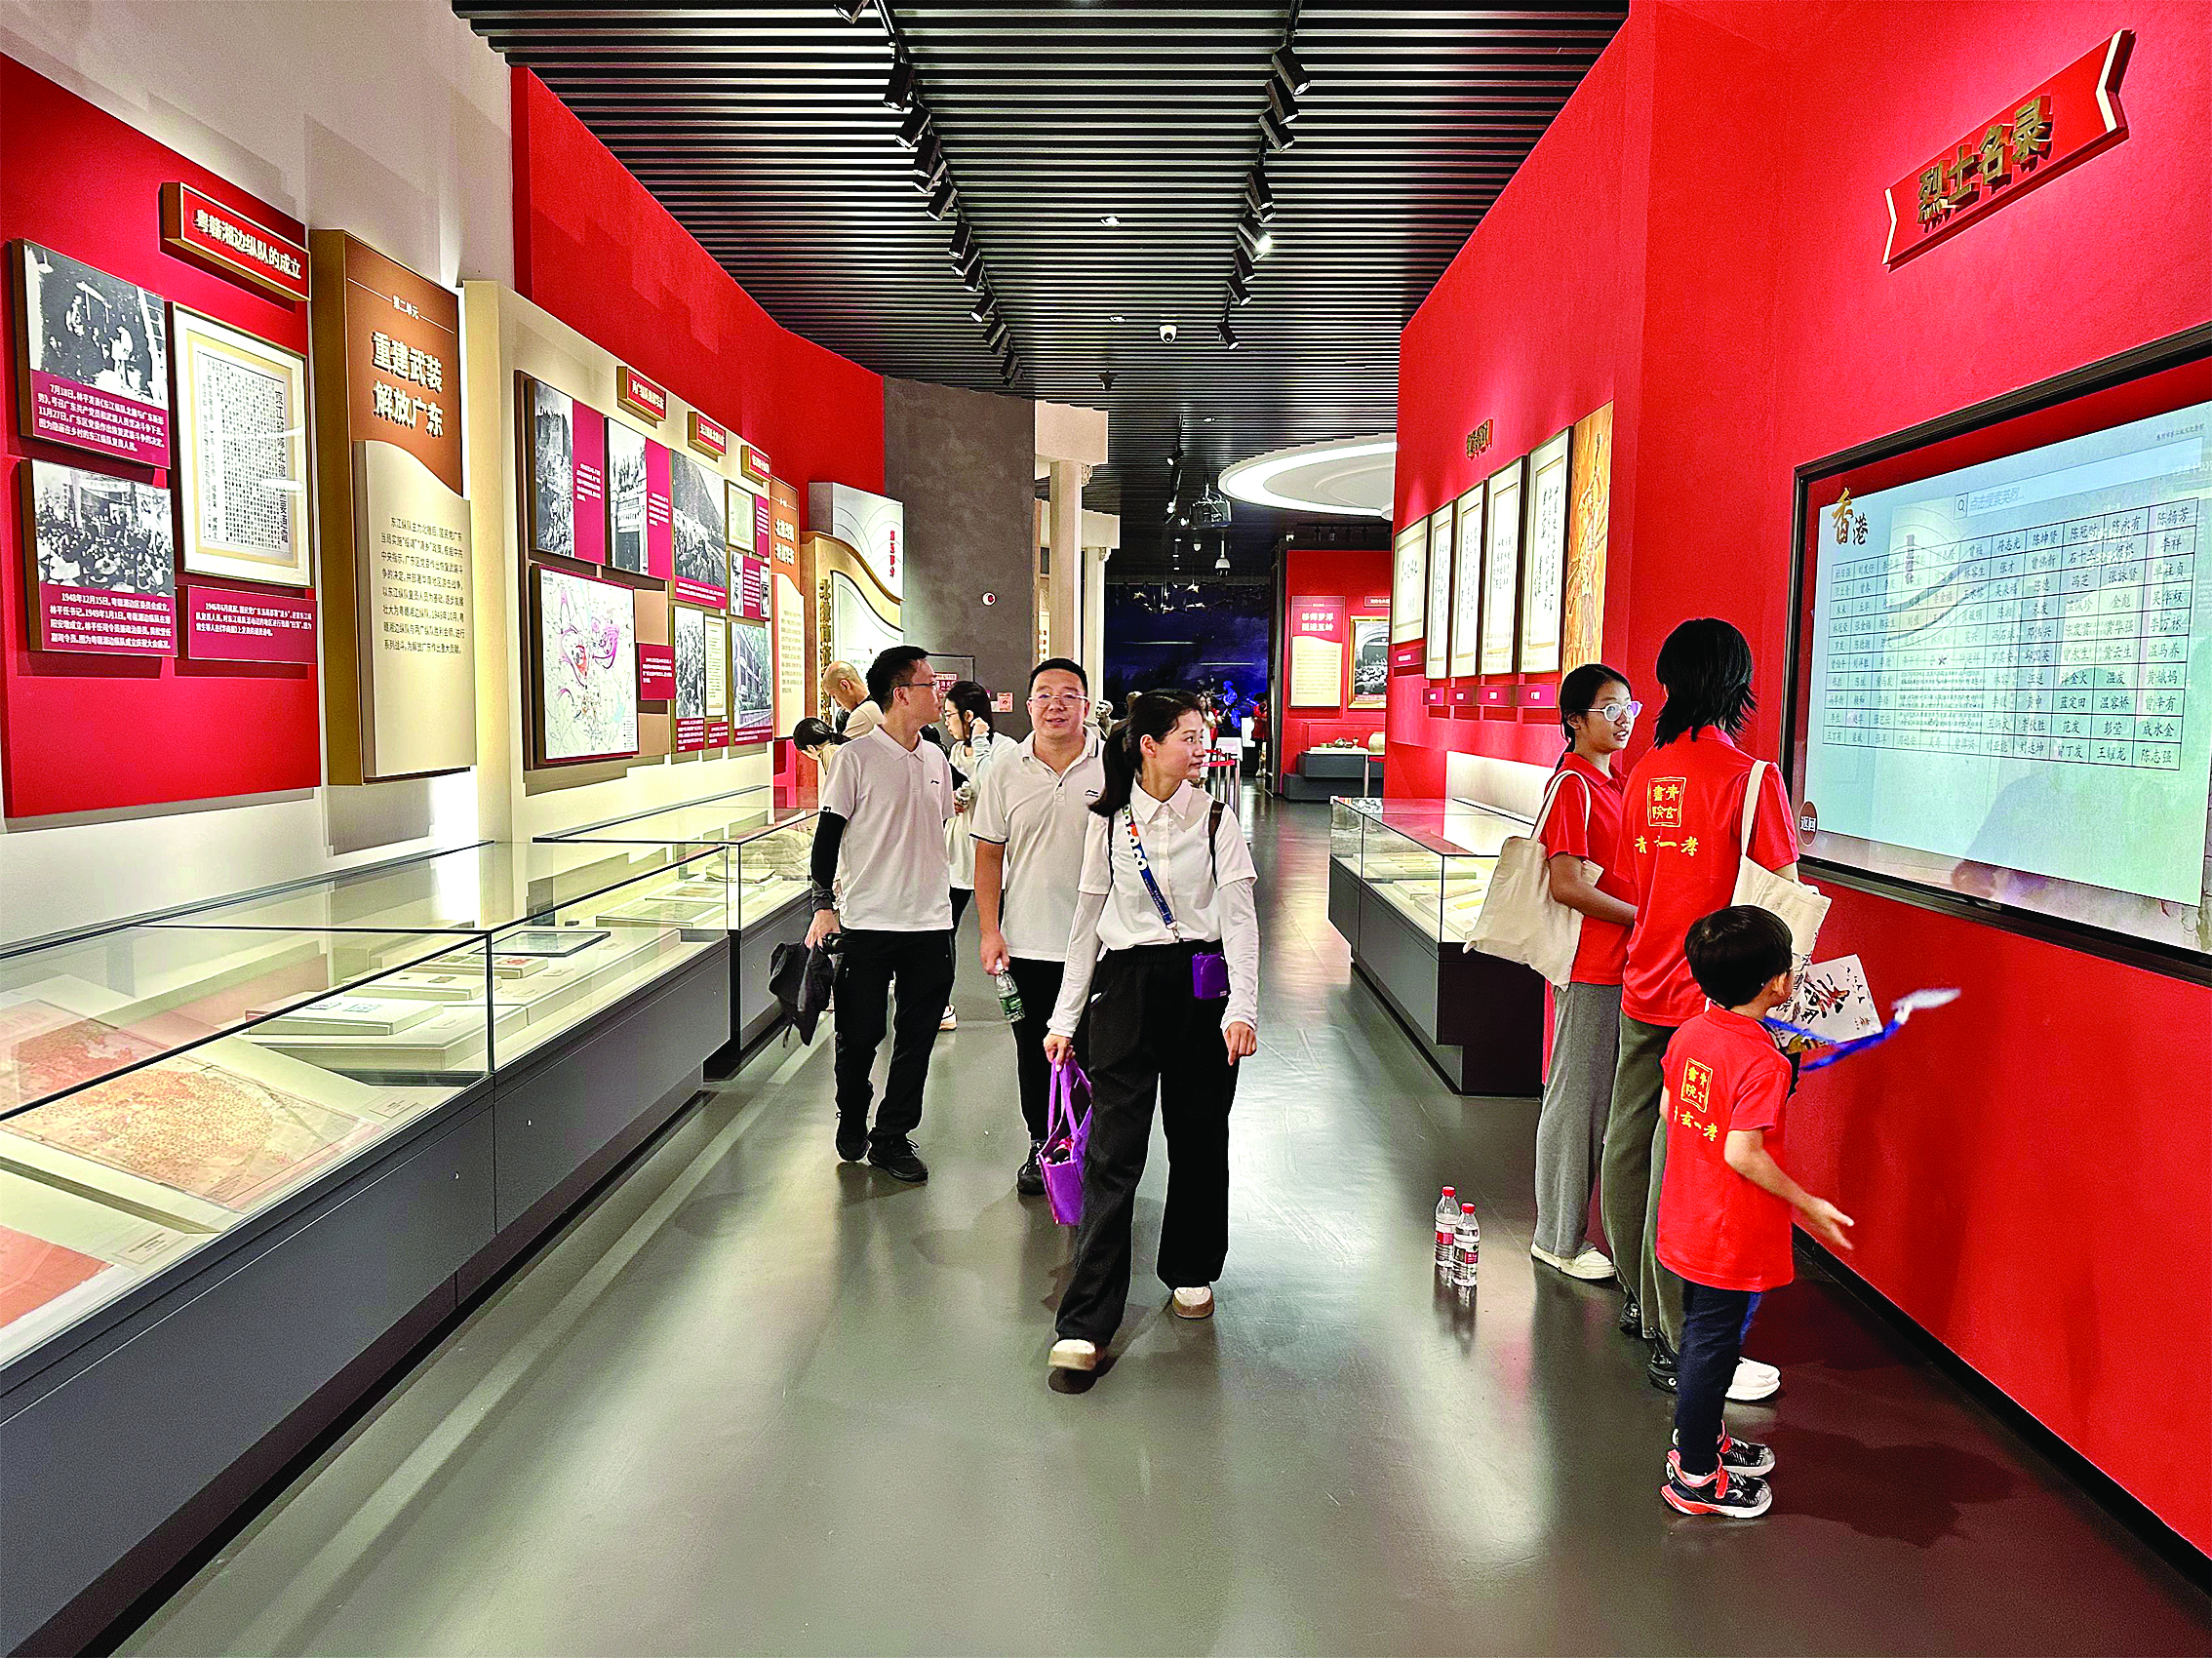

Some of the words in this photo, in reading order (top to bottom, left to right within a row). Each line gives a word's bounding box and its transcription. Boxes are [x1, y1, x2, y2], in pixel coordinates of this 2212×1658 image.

[1917, 96, 2051, 227] 烈士名录
[196, 210, 301, 279] 粤赣湘边纵队的成立
[393, 295, 418, 319] 第二单元
[373, 332, 442, 393] 重建武装
[374, 380, 443, 437] 解放广东
[1832, 488, 1868, 545] 香港
[2159, 534, 2183, 553] 李祥
[2139, 747, 2173, 764] 陈志强
[1800, 815, 1816, 832] 返回
[1675, 1106, 1718, 1142] 玄一孝
